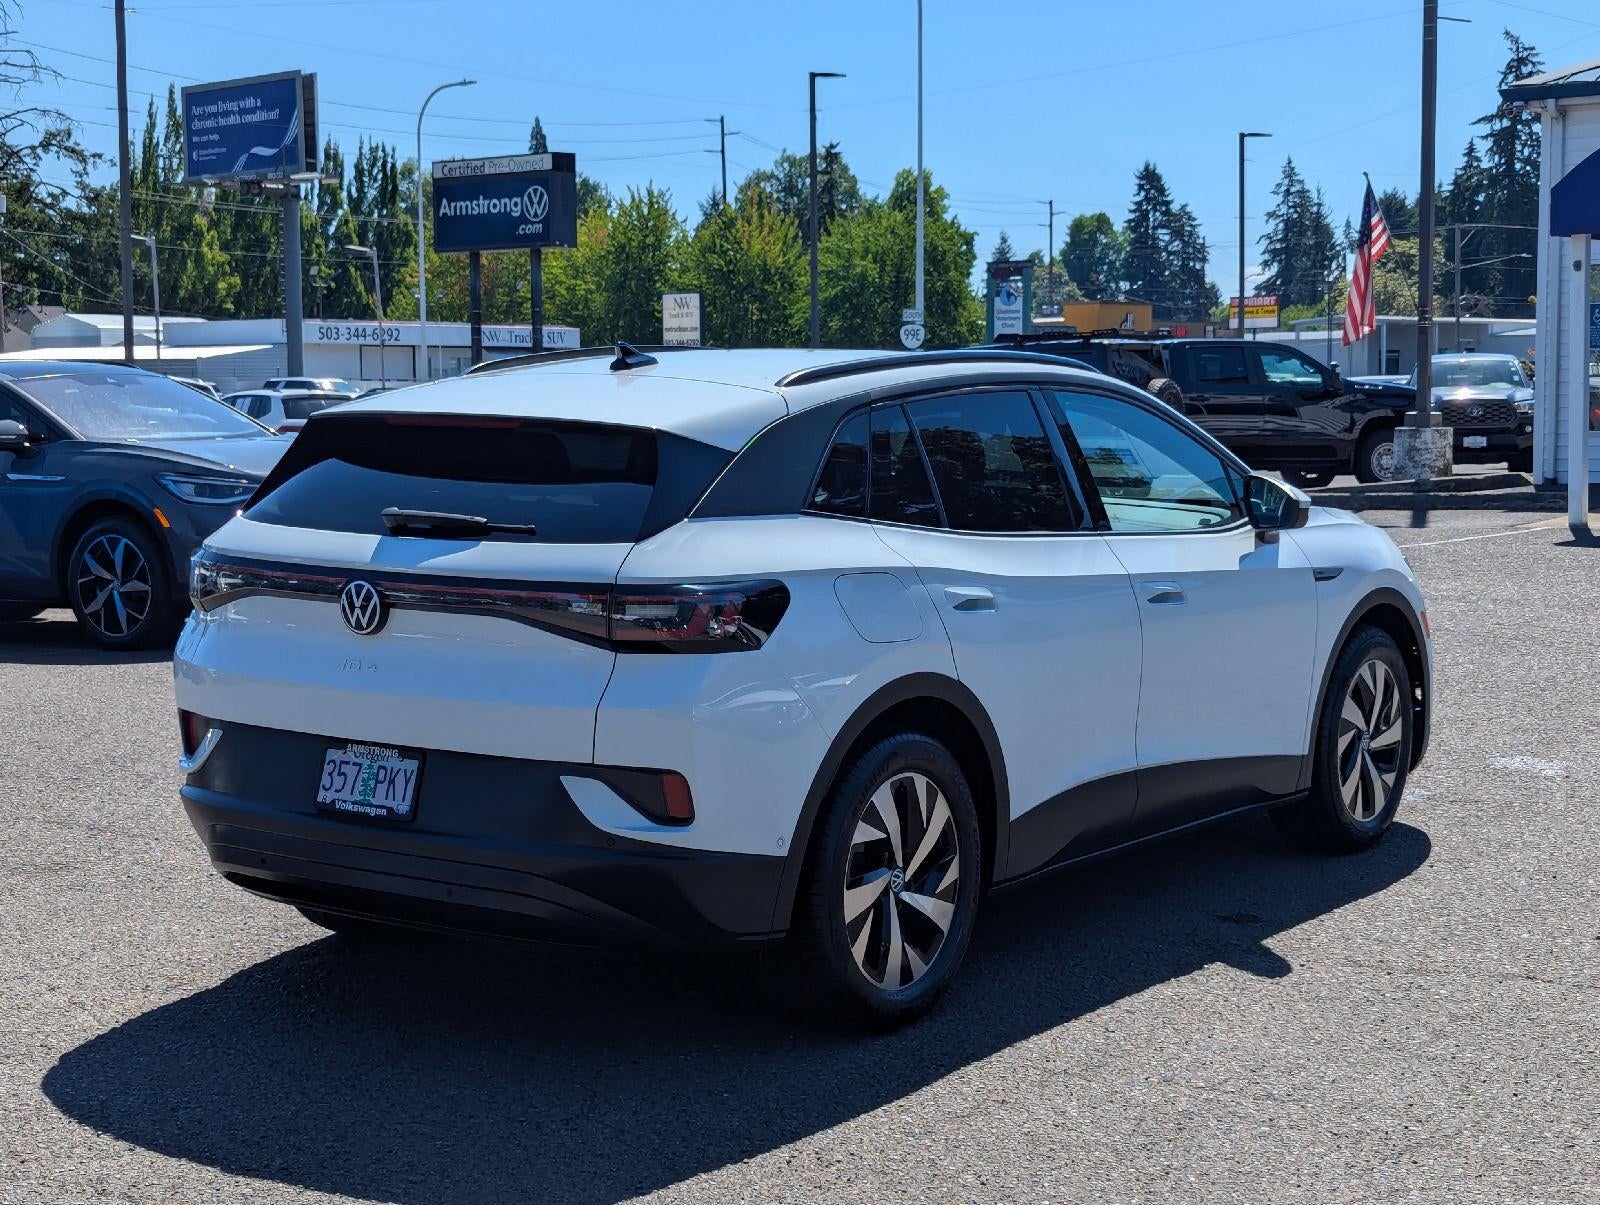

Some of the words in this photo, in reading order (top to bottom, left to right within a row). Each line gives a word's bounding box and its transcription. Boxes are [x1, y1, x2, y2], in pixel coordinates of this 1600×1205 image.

[192, 105, 204, 116] Are
[204, 104, 218, 116] you
[218, 101, 239, 112] living
[239, 97, 256, 108] with
[256, 98, 262, 107] a
[191, 117, 218, 131] chronic
[218, 113, 241, 127] health
[241, 108, 280, 123] condition?
[441, 161, 486, 177] Certified
[488, 157, 544, 172] Pre-Owned
[439, 194, 522, 217] Armstrong
[515, 223, 543, 235] .com
[673, 296, 692, 311] NW
[482, 329, 501, 343] NW
[546, 331, 567, 345] SUV
[903, 328, 921, 341] 99E
[346, 743, 399, 758] ARMSTRONG
[322, 759, 364, 796] 357
[372, 765, 415, 803] PKY
[335, 800, 387, 816] Volkswagen
